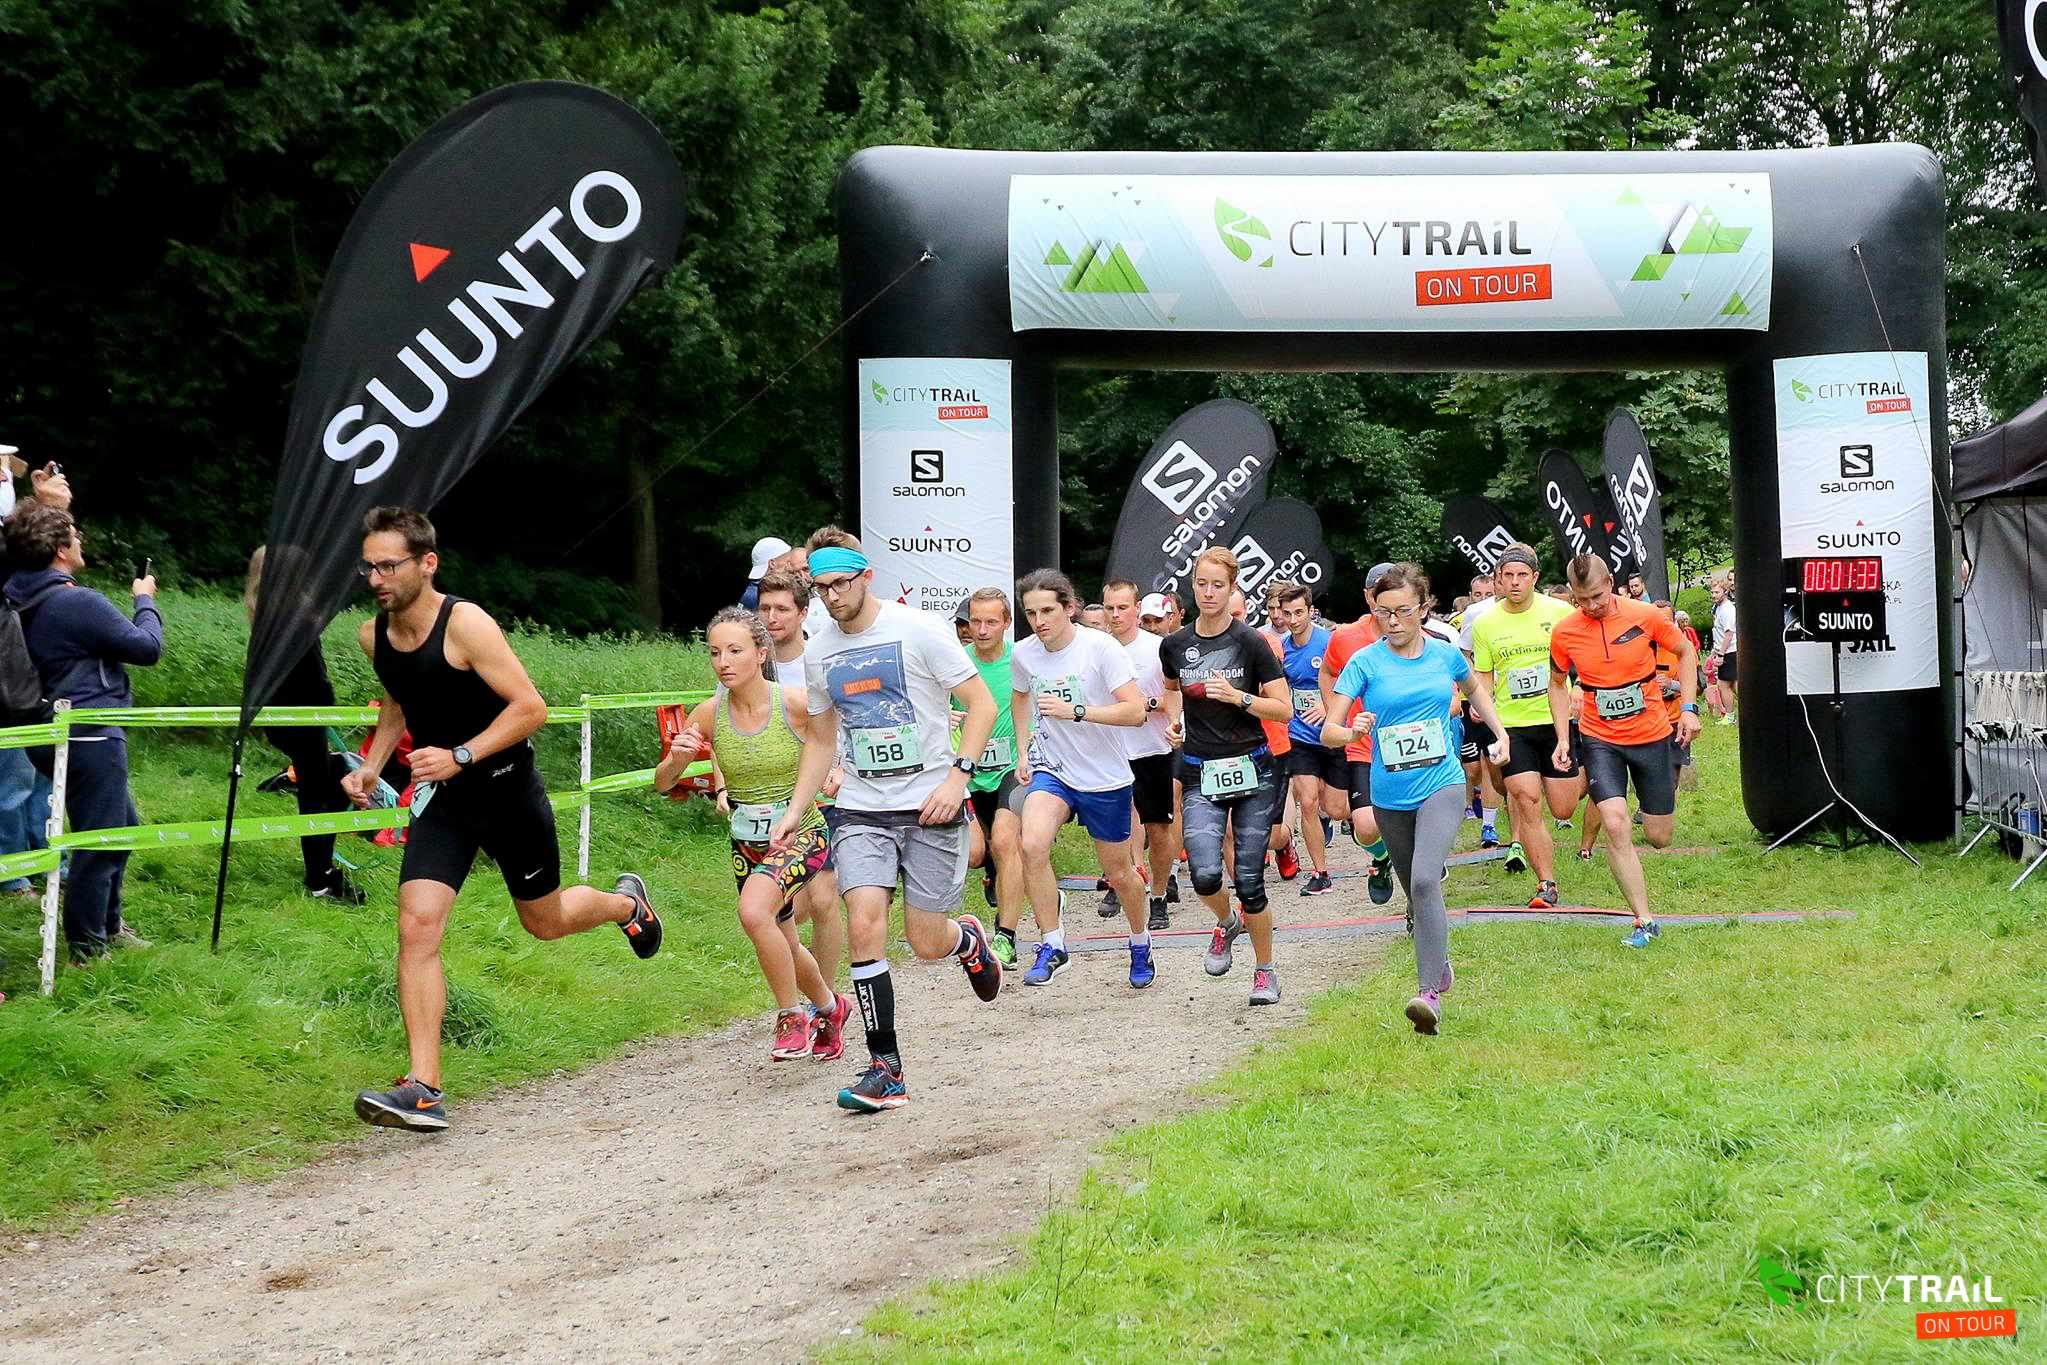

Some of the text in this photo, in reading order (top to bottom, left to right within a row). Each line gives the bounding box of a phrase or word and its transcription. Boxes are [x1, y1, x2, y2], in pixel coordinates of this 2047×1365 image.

[1426, 272, 1538, 299] ON TOUR
[323, 170, 642, 485] SUUNTO
[941, 407, 984, 417] ON TOUR
[1870, 401, 1908, 412] ON TOUR
[888, 537, 972, 553] SUUNTO
[1817, 531, 1901, 550] SUUNTO
[1803, 561, 1879, 591] 00:01:33
[921, 587, 970, 598] POLSKA
[1818, 612, 1873, 630] SUUNTO
[1517, 675, 1538, 690] 137
[1605, 696, 1635, 711] 403
[867, 743, 905, 764] 158
[1395, 736, 1430, 756] 124
[983, 749, 997, 762] 71
[1213, 770, 1244, 788] 168
[748, 818, 772, 835] 77
